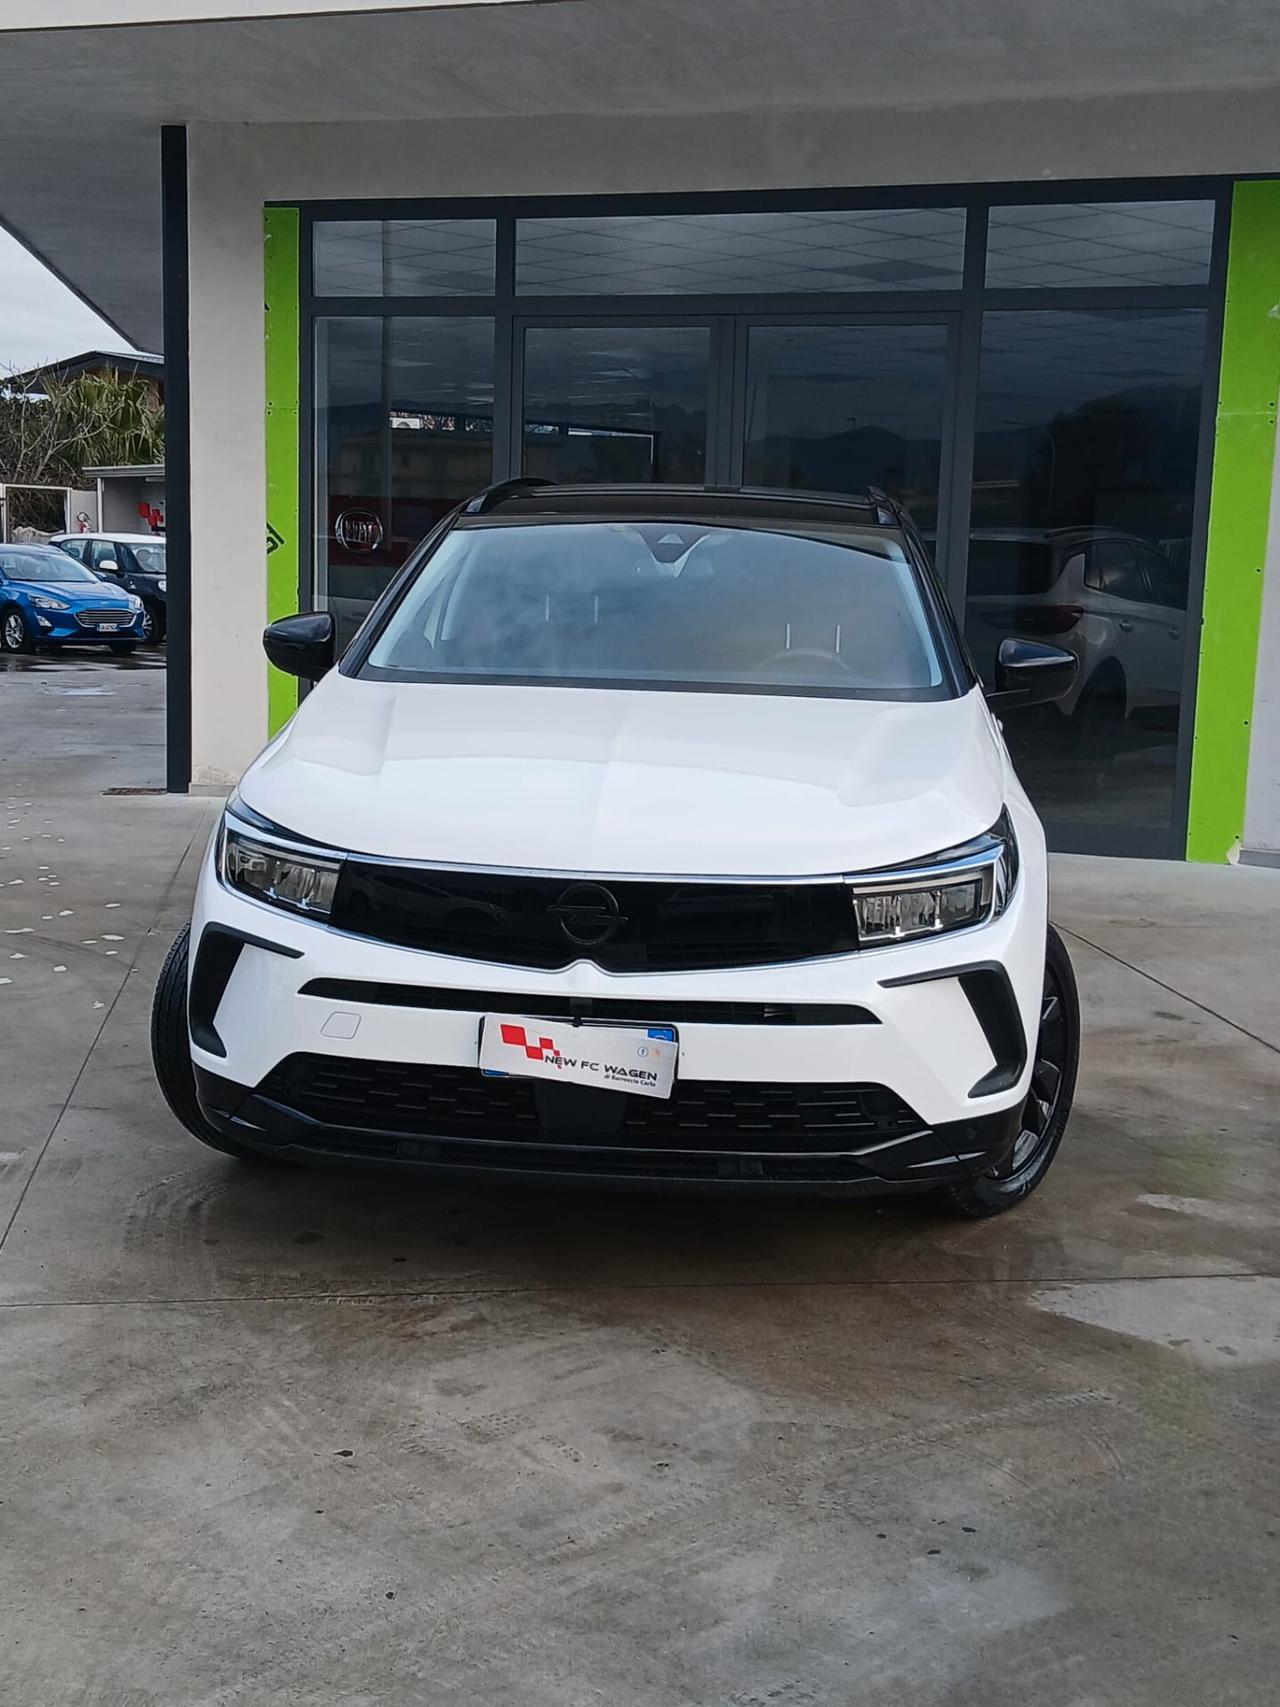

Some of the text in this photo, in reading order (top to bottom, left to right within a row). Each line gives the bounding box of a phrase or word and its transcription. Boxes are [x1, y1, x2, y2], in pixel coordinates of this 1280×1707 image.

[544, 1054, 658, 1081] NEW FC WAGEN
